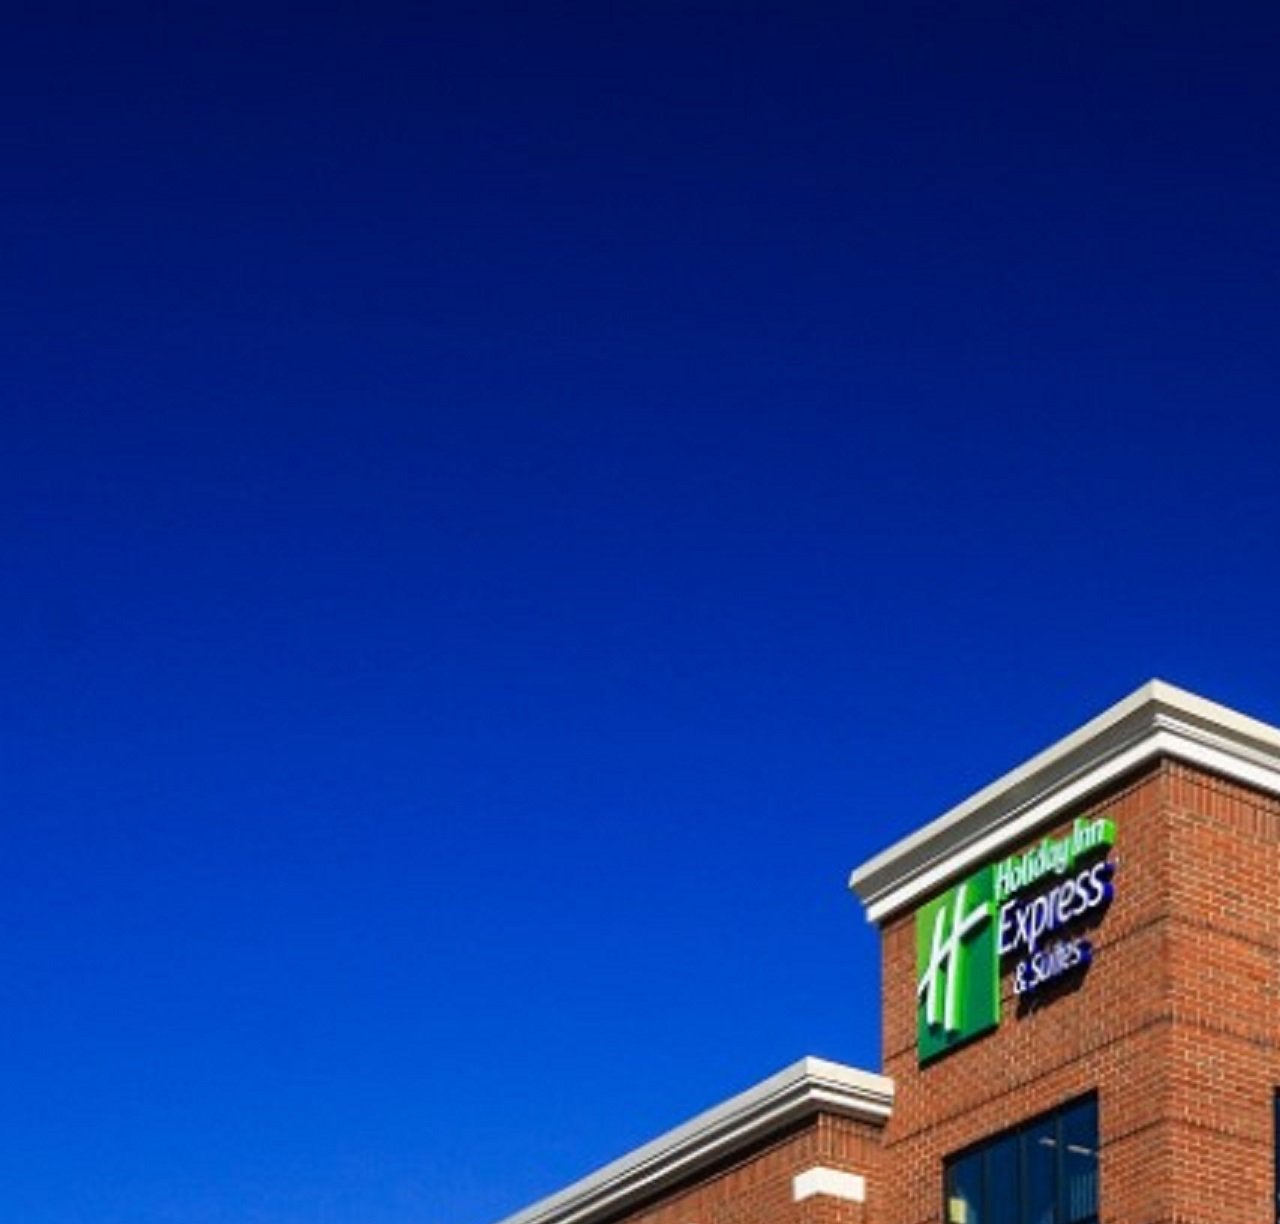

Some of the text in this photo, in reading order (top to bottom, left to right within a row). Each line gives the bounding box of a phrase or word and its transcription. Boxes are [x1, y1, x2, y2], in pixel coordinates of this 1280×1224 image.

[996, 818, 1113, 898] Holiday Inn
[998, 861, 1109, 955] Express
[1029, 938, 1083, 986] Suites
